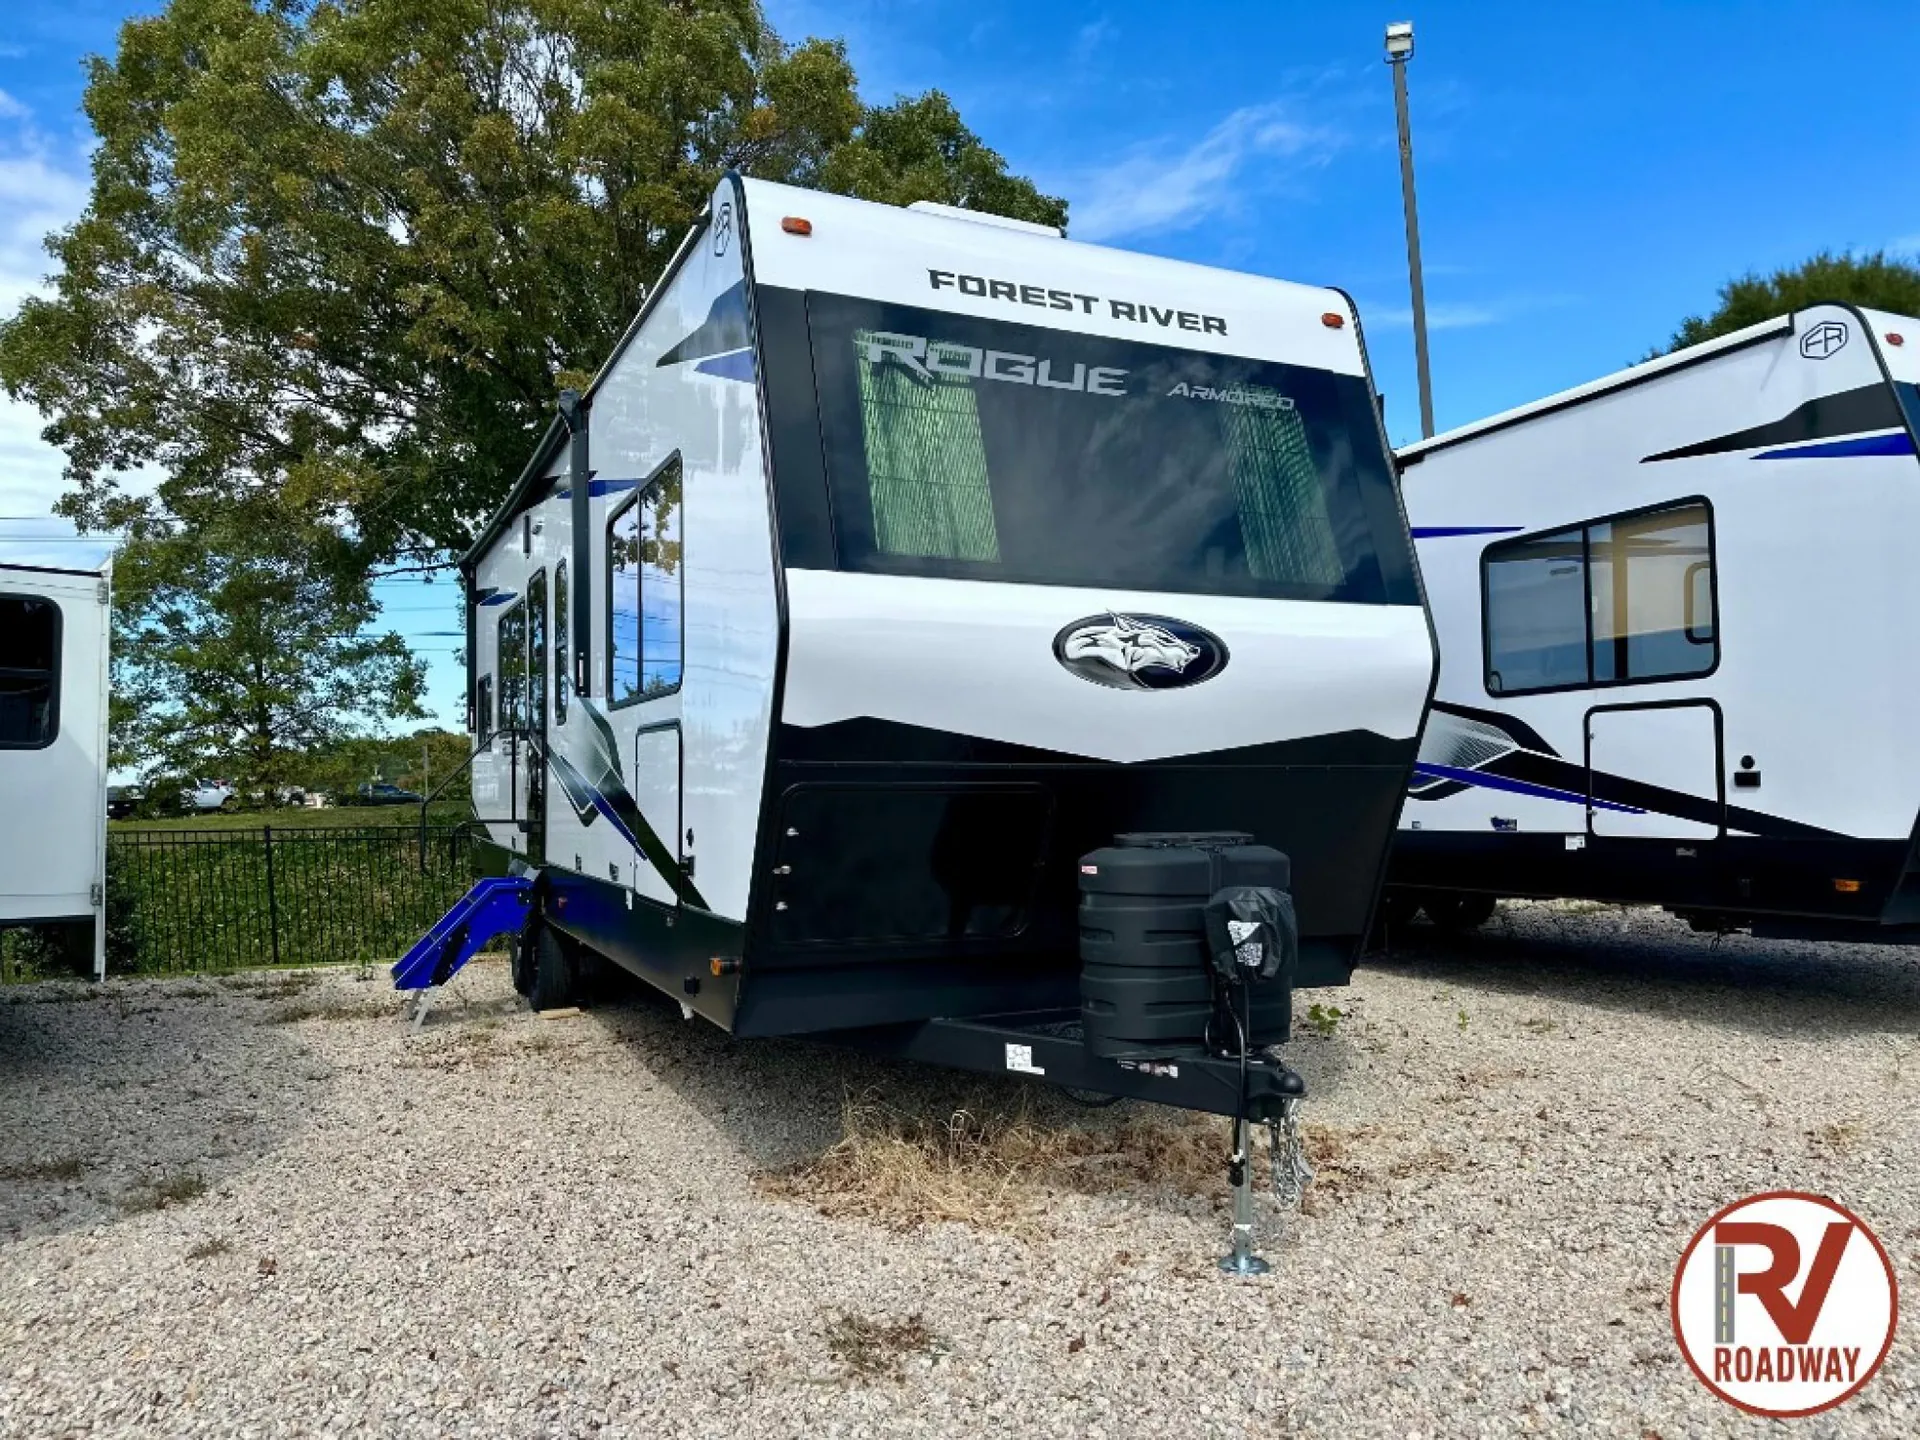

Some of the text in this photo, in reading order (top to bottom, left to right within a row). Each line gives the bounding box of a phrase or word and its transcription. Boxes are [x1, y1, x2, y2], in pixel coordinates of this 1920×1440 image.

[927, 268, 1228, 336] FOREST RIVER
[1805, 325, 1843, 353] FR
[854, 331, 1129, 396] ROGUE
[1166, 382, 1295, 410] ARMORED
